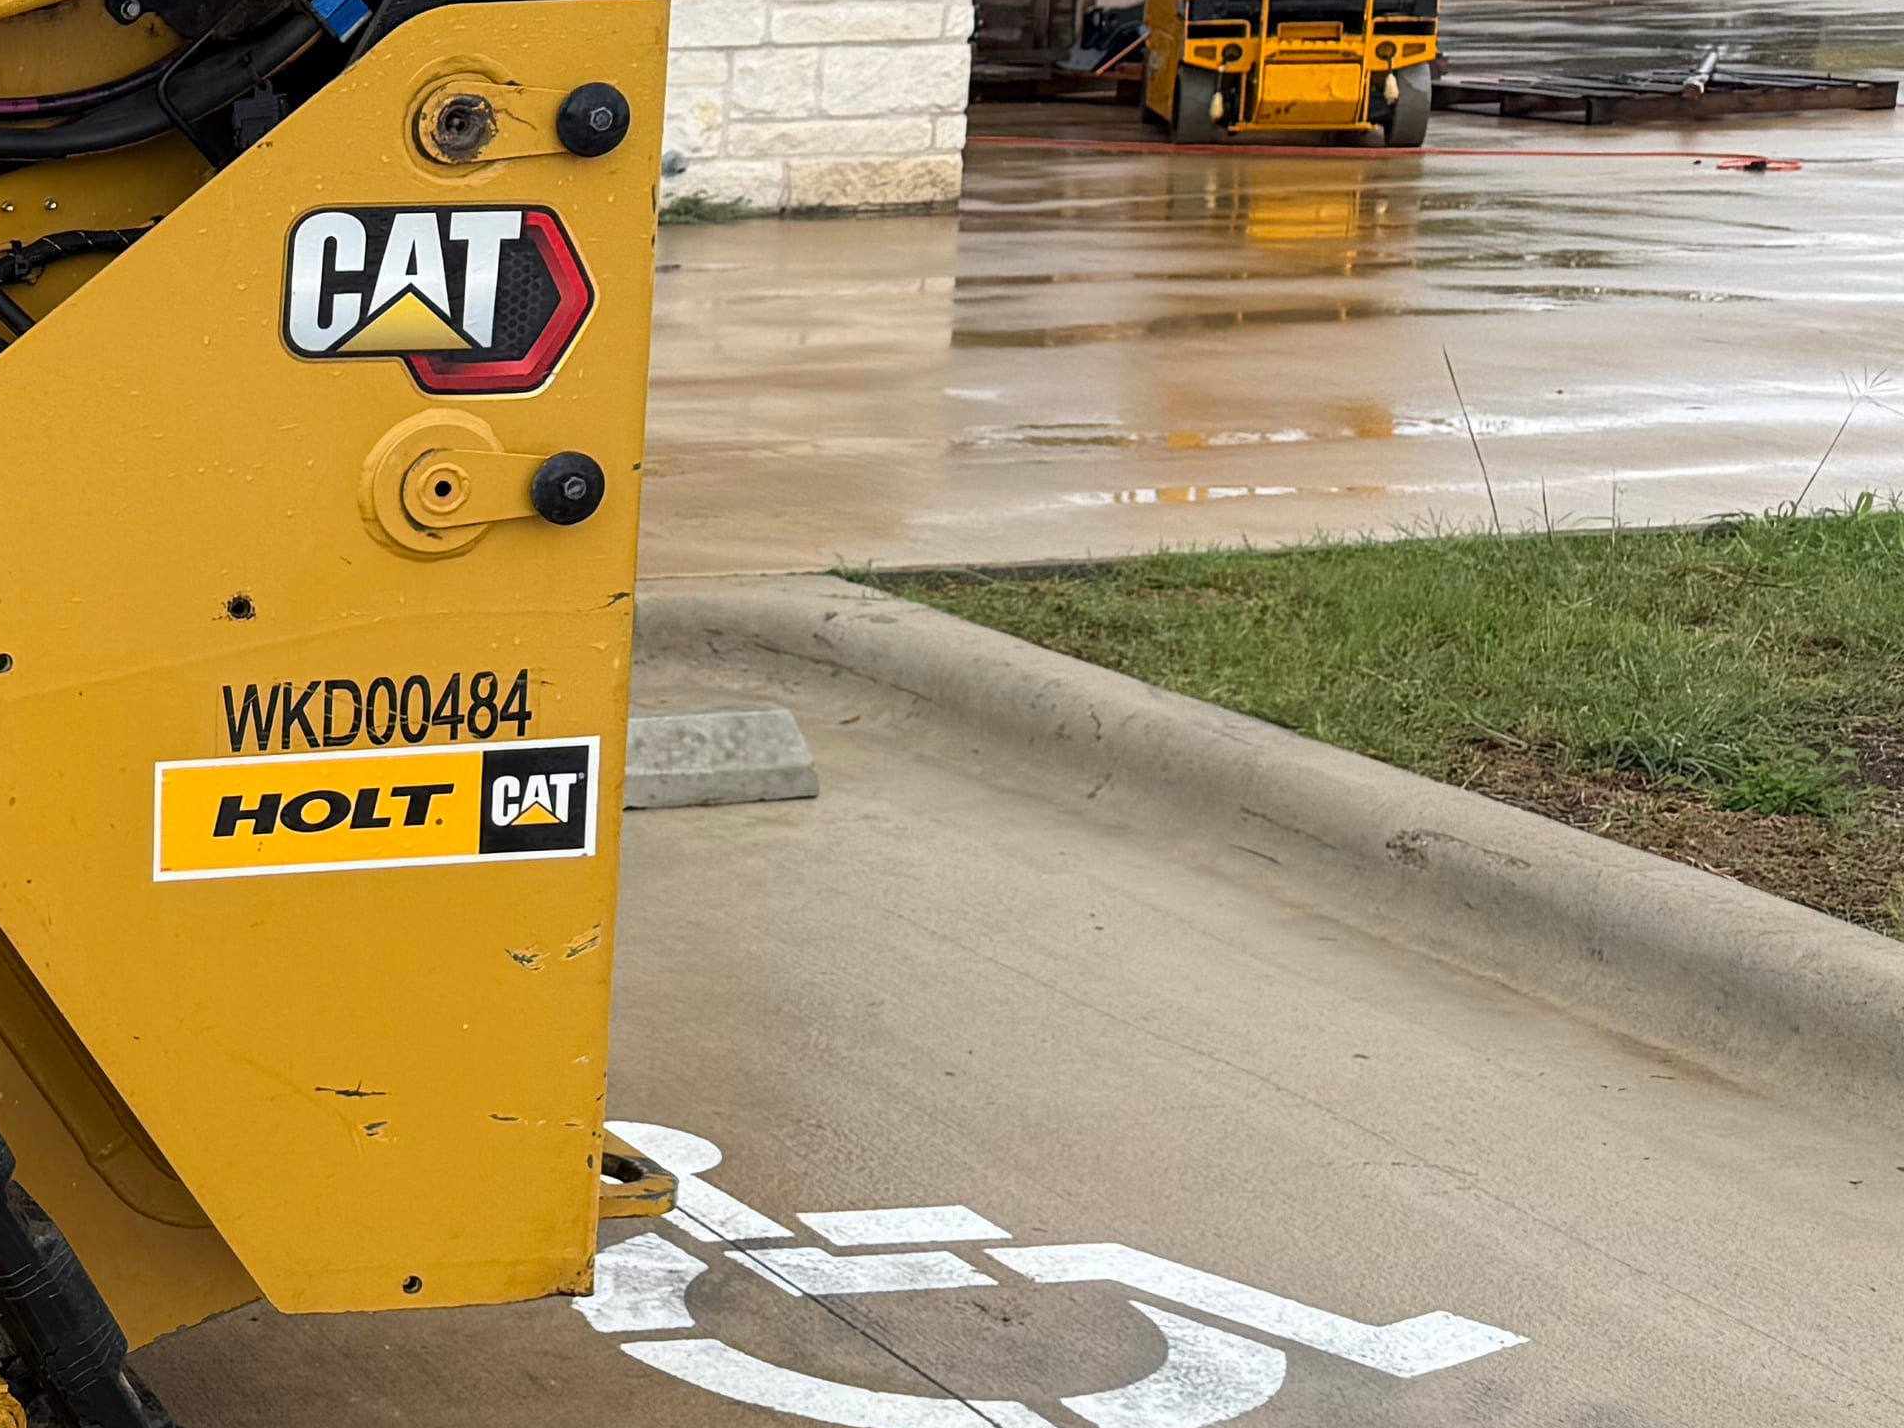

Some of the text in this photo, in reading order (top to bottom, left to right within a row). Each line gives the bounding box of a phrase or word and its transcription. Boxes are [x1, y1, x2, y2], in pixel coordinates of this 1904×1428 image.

[289, 210, 523, 352] CAT
[222, 668, 532, 753] WKD00484
[212, 772, 578, 838] HOLT CAT
